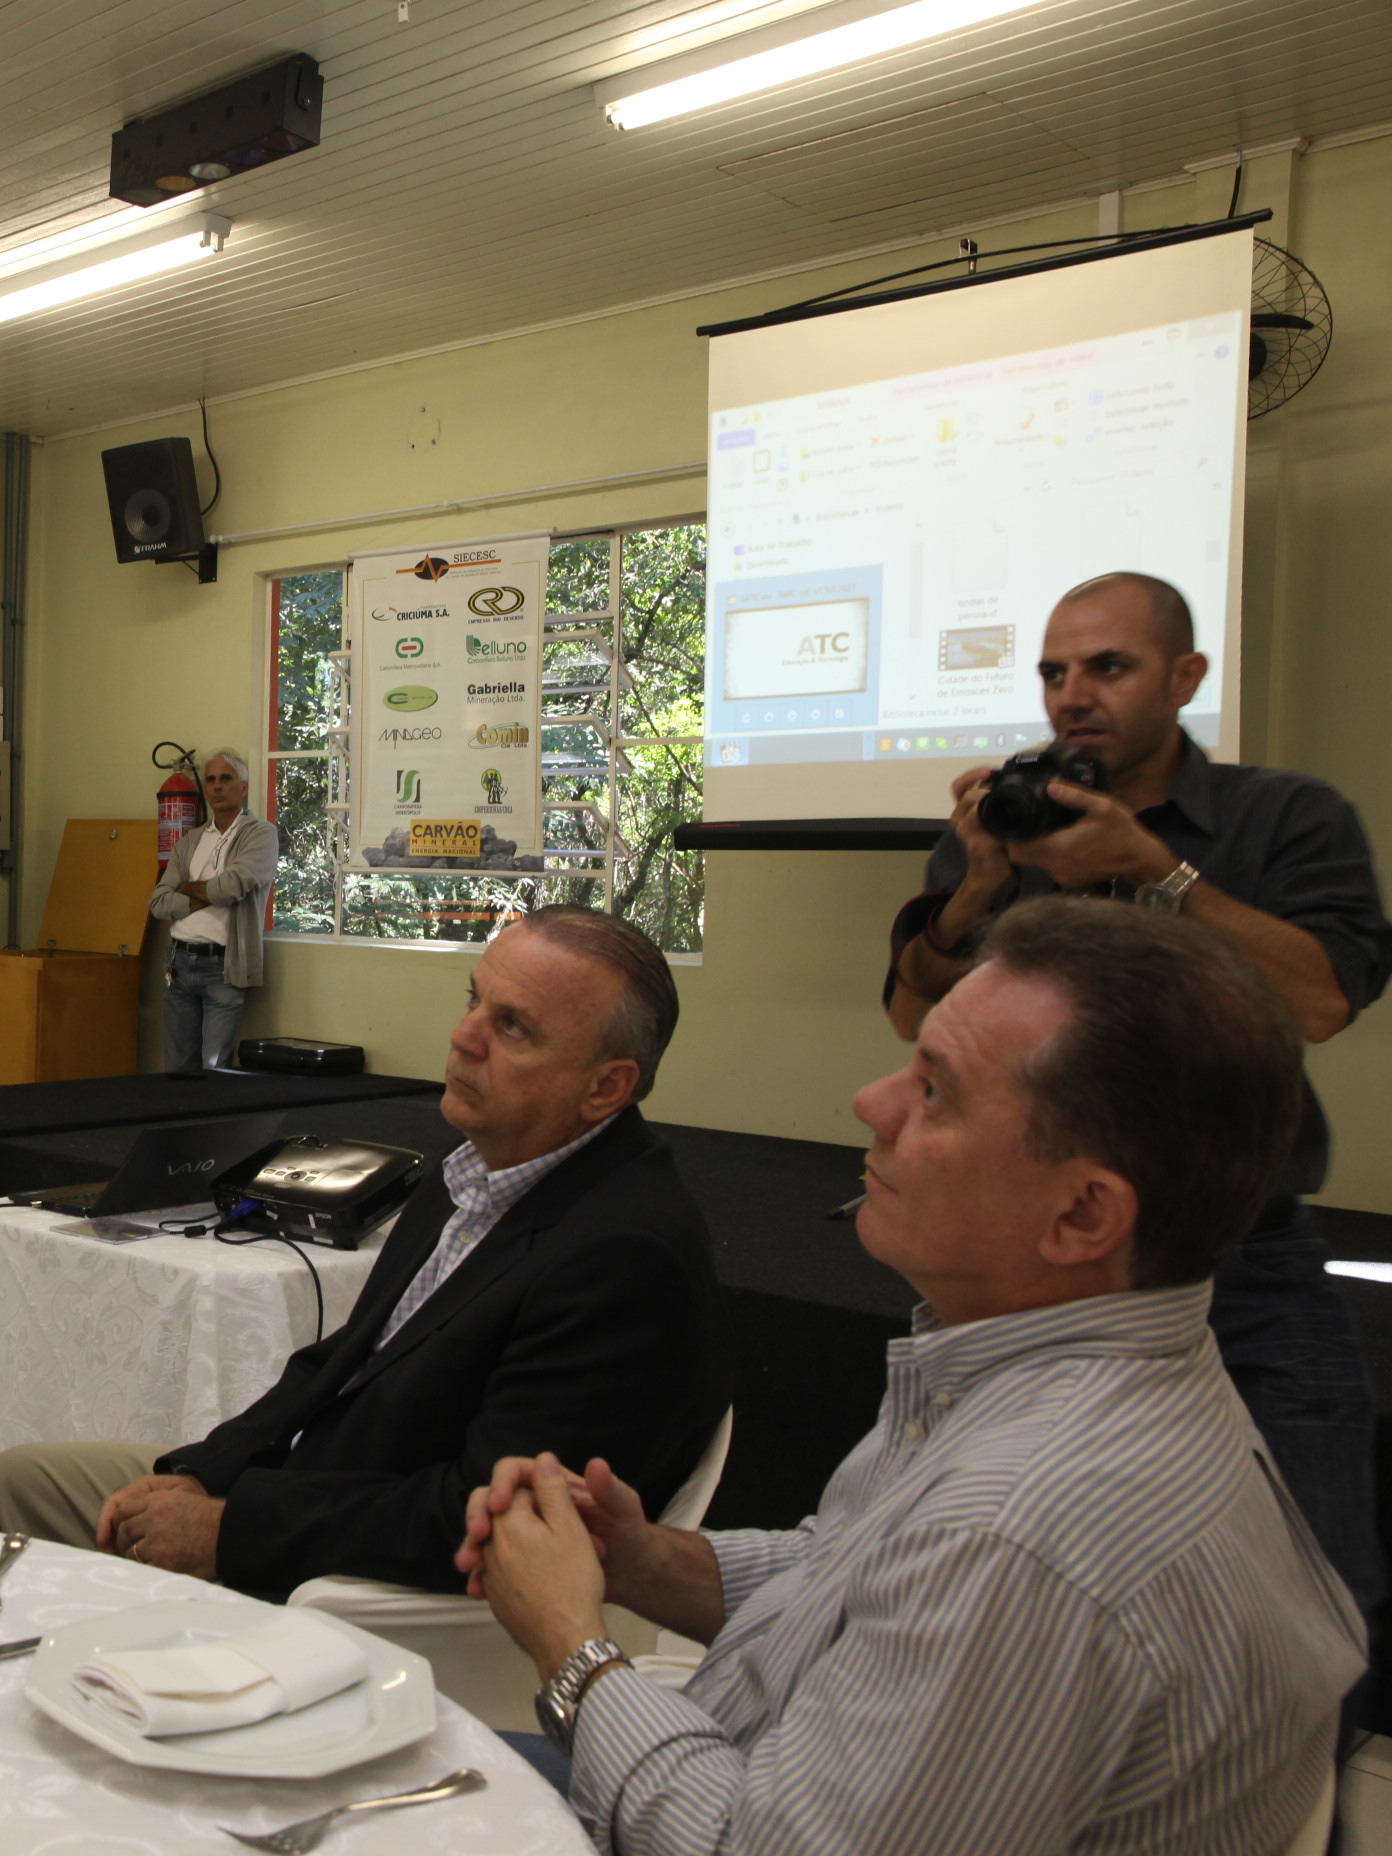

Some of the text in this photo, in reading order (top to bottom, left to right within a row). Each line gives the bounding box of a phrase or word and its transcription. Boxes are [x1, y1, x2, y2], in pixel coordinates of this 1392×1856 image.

[453, 549, 496, 563] SIECESC
[987, 595, 999, 604] de
[396, 607, 433, 621] CRICIÚMA
[435, 608, 450, 618] S.A.
[796, 631, 850, 656] ATC
[937, 674, 969, 685] Cidade
[971, 673, 983, 683] do
[468, 682, 525, 695] Gabriella
[937, 688, 948, 698] de
[992, 685, 1014, 695] Zero
[467, 695, 505, 705] Mineração
[476, 722, 529, 745] Comin
[412, 820, 478, 839] CARVÃO
[168, 1159, 215, 1175] VAIO
